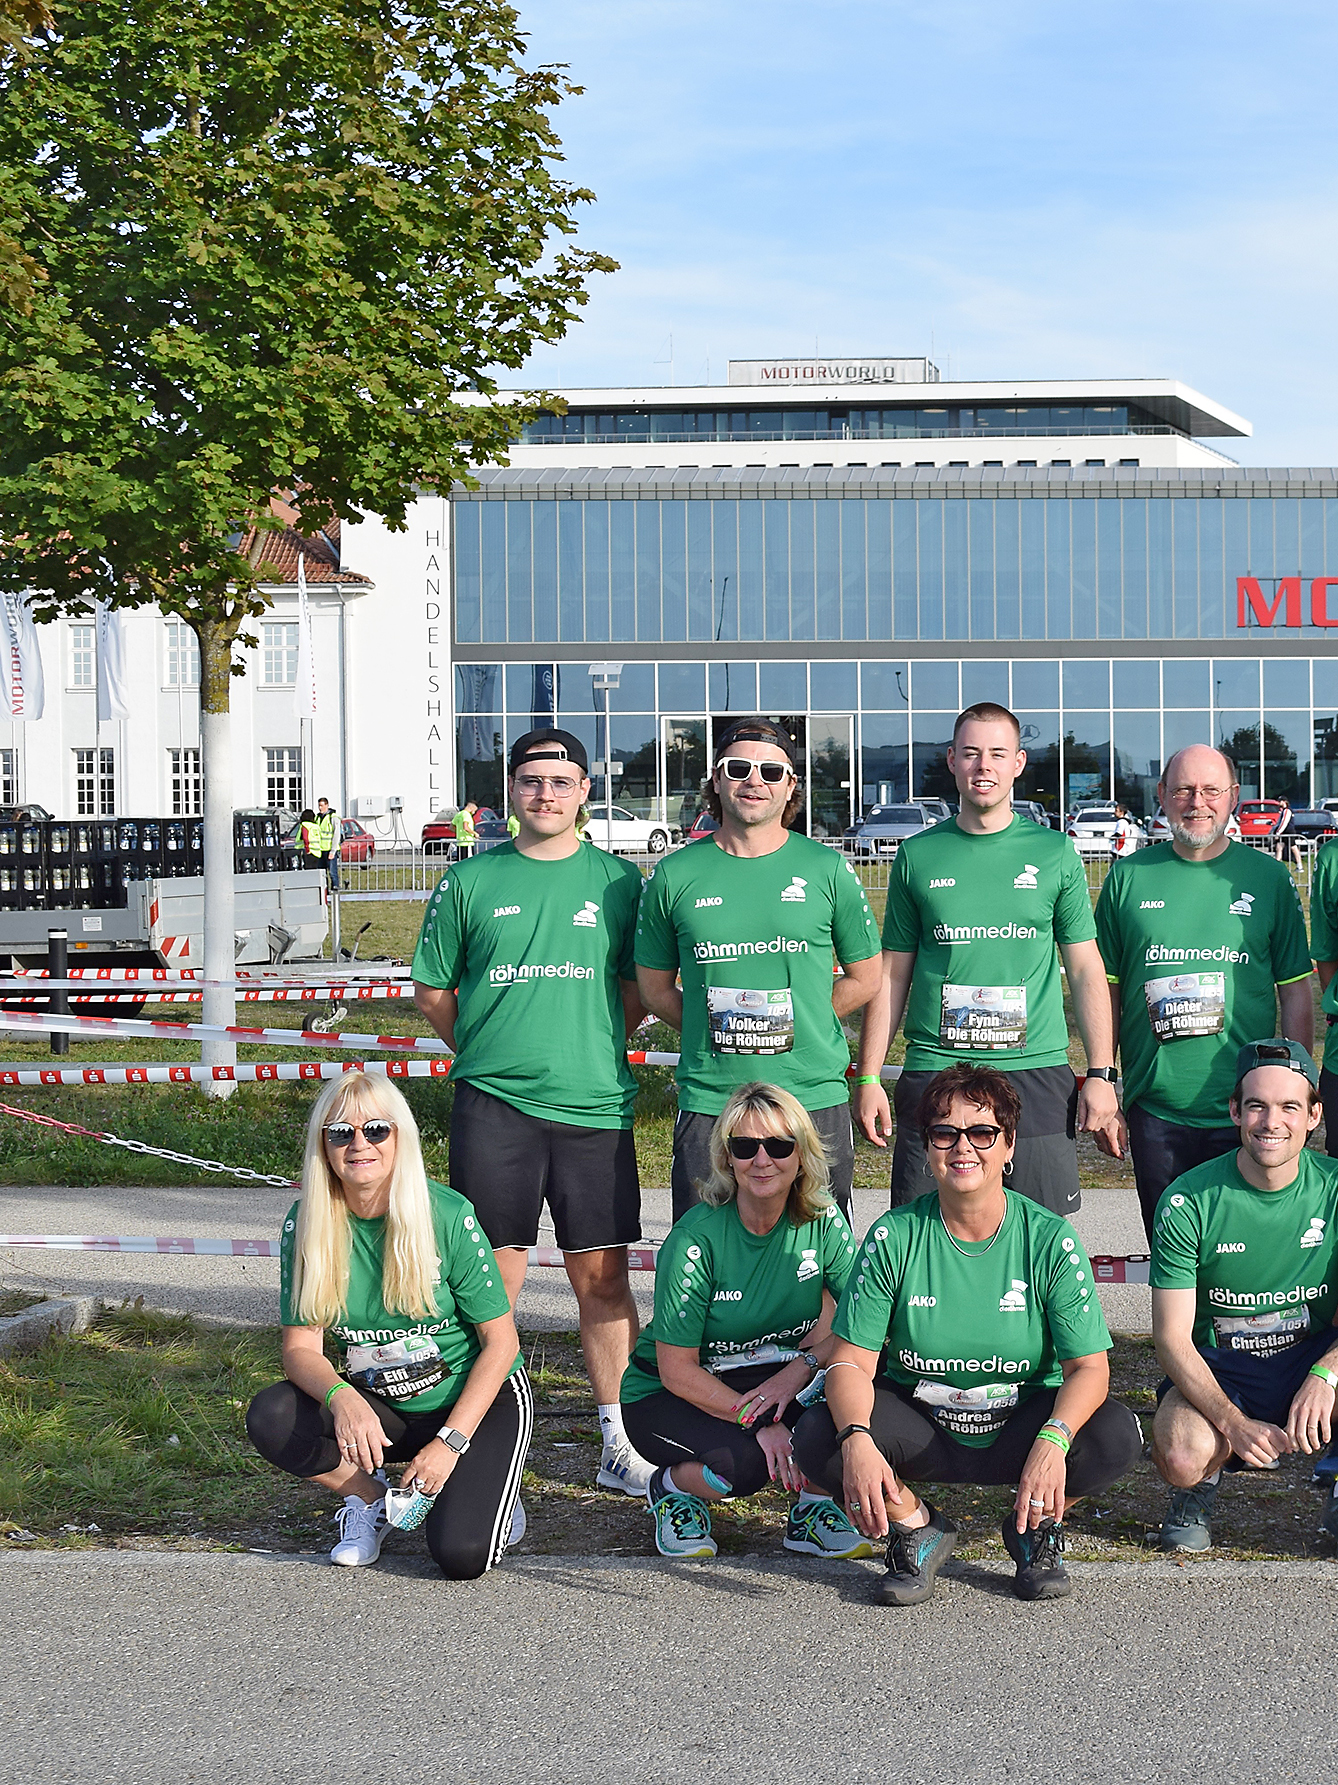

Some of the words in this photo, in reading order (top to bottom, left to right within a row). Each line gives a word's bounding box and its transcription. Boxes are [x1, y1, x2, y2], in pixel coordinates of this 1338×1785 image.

[761, 366, 895, 379] MOTORWORLD
[426, 531, 441, 813] HANDELSHALLE
[929, 878, 956, 889] JAKO
[694, 896, 723, 908] JAKO
[1139, 900, 1165, 909] JAKO
[493, 905, 521, 917] JAKO
[933, 921, 1037, 940] röhmmedien
[694, 936, 808, 958] röhmmedien
[1145, 944, 1249, 964] röhmmedien
[1165, 1000, 1202, 1015] Dieter
[728, 1016, 770, 1032] Volker
[968, 1013, 1000, 1029] Fynn
[1155, 1020, 1171, 1033] Die
[1172, 1016, 1219, 1029] Röhmer
[714, 1031, 733, 1045] Die
[736, 1032, 788, 1047] Röhmer
[947, 1027, 967, 1040] Die
[971, 1028, 1020, 1042] Röhmer
[1216, 1243, 1245, 1253] JAKO
[714, 1291, 742, 1301] JAKO
[908, 1295, 936, 1307] JAKO
[1209, 1284, 1328, 1305] röhmmedien
[1281, 1318, 1307, 1331] 1051
[1231, 1334, 1294, 1350] Christian
[900, 1349, 1030, 1373] röhmmedien
[383, 1368, 409, 1383] Elfi
[386, 1371, 443, 1397] Röhmer
[987, 1397, 1017, 1409] 1058
[938, 1409, 992, 1422] Andrea
[950, 1419, 1008, 1434] Röhmer
